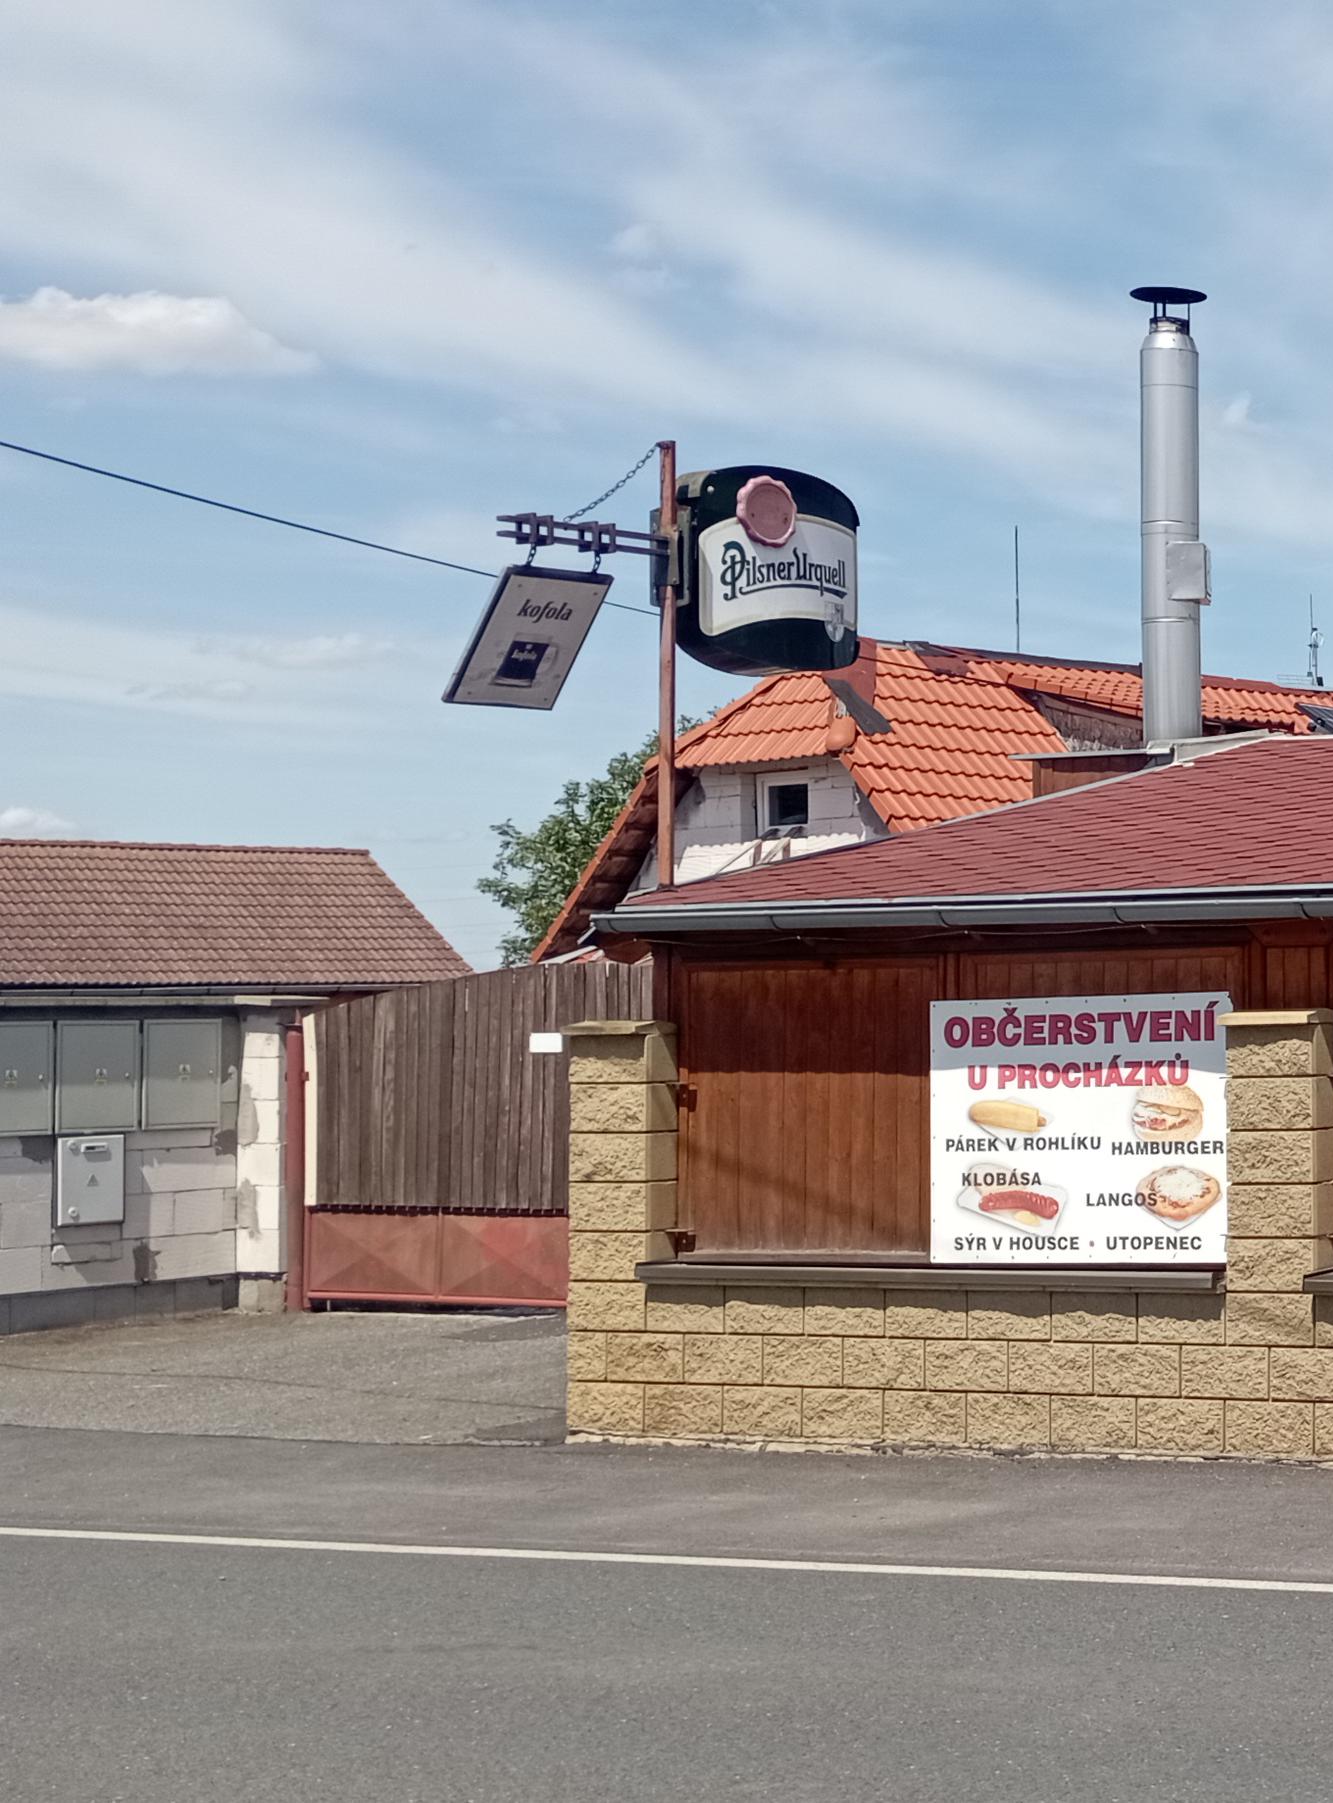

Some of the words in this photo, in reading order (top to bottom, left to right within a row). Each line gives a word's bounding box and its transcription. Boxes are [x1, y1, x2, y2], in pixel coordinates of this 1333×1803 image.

[720, 541, 795, 601] Pilsner
[792, 547, 847, 597] Urquell
[516, 598, 573, 624] kofola
[943, 1001, 1220, 1049] OBČERSTVENÍ
[967, 1065, 988, 1090] U
[997, 1053, 1190, 1090] PROCHÁZKŮ
[945, 1134, 1000, 1153] PÁREK
[1005, 1137, 1017, 1151] V
[1023, 1132, 1102, 1151] ROHLÍKU
[1111, 1140, 1225, 1156] HAMBURGER
[961, 1171, 1042, 1187] KLOBÁSA
[1086, 1192, 1158, 1207] LANGOS
[954, 1233, 987, 1251] SÝR
[992, 1237, 1003, 1250] V
[1009, 1237, 1080, 1251] HOUSCE
[1106, 1236, 1202, 1251] UTOPENEC
